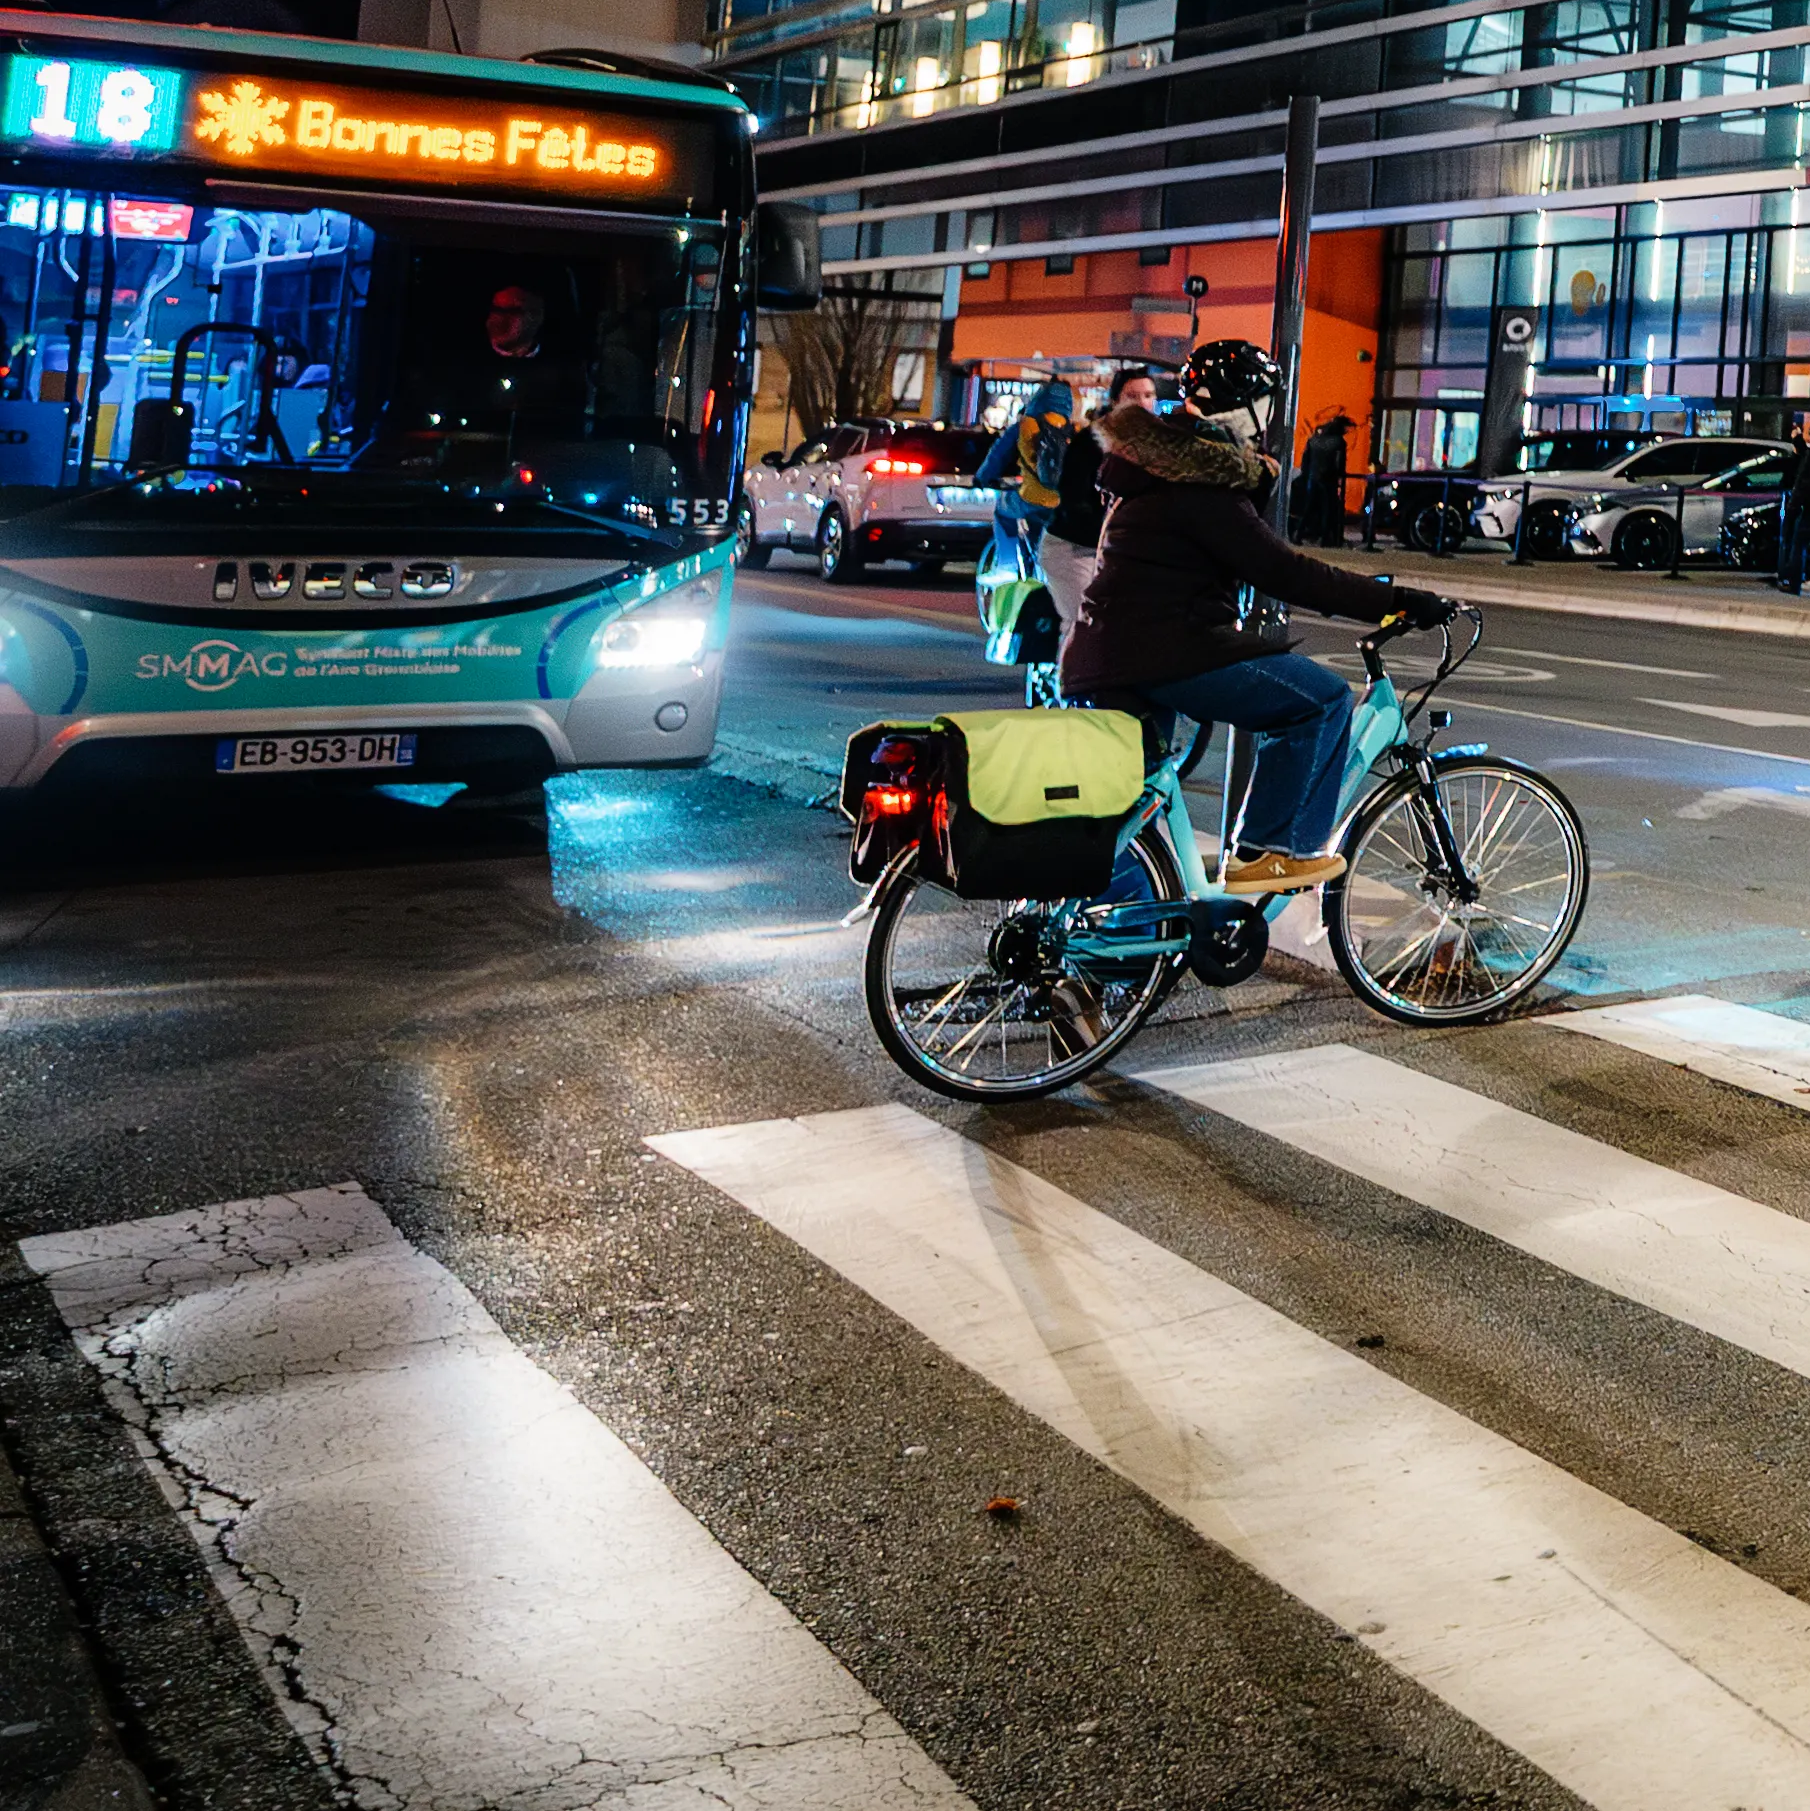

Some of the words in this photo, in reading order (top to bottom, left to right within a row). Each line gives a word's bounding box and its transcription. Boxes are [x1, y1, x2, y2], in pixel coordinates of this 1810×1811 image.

[29, 61, 156, 142] 18
[296, 98, 497, 163] Bonnes
[507, 117, 658, 178] Fêtes
[666, 497, 729, 525] 553
[213, 561, 455, 602] IVECO
[137, 640, 287, 690] SMMAG
[239, 739, 397, 766] EB-953-DH
